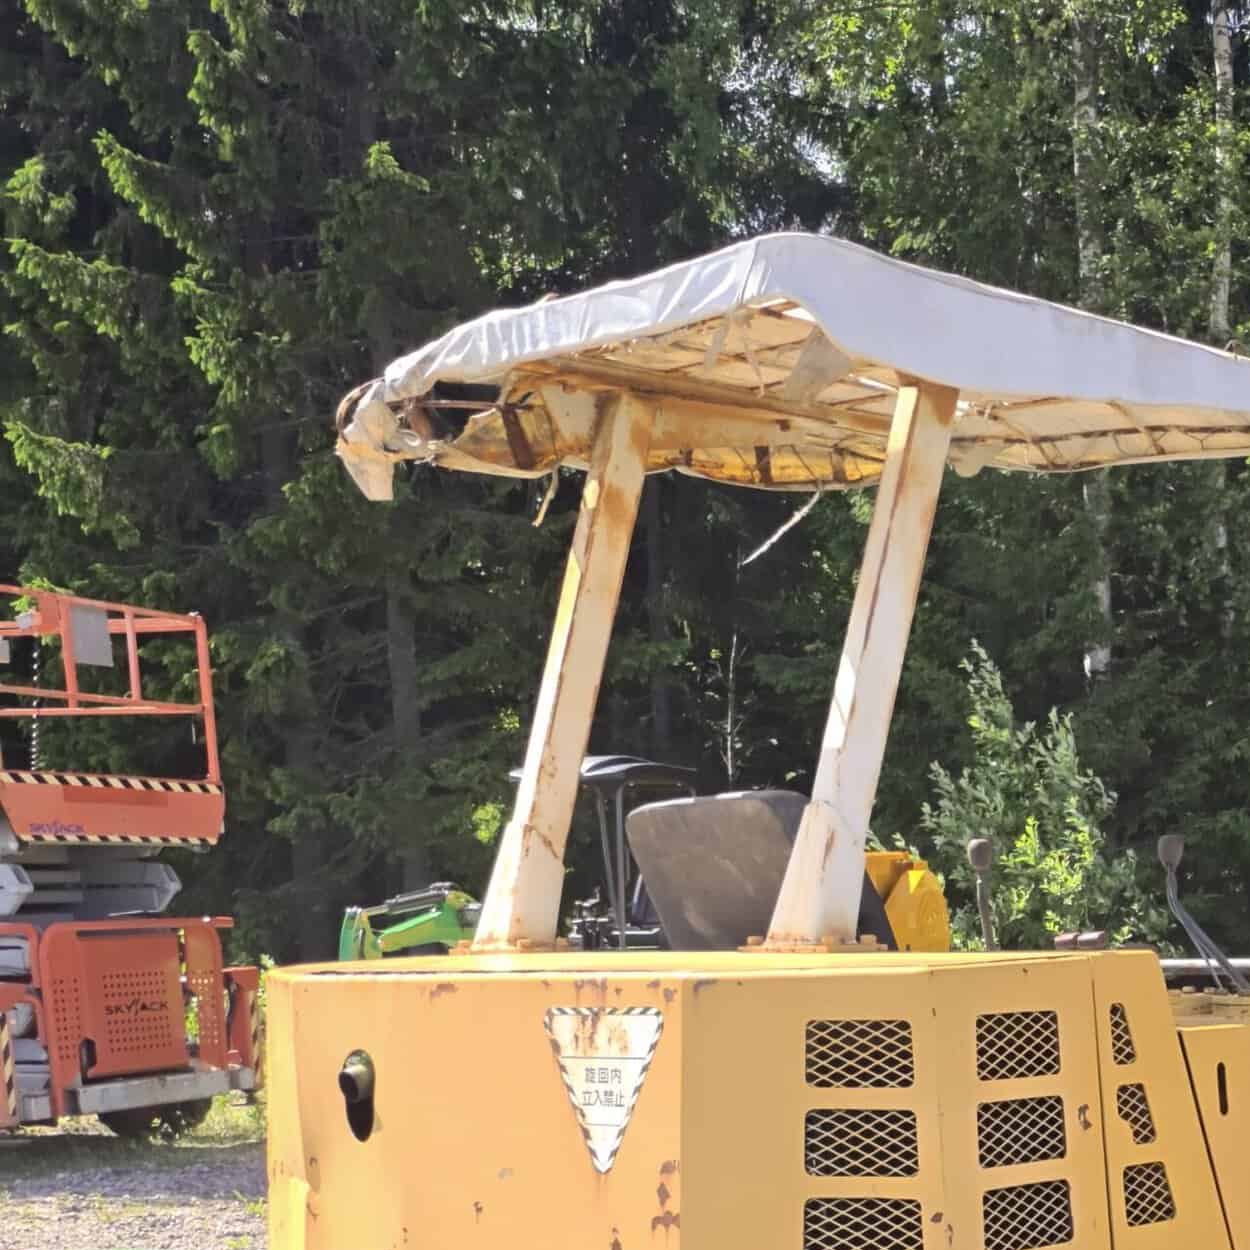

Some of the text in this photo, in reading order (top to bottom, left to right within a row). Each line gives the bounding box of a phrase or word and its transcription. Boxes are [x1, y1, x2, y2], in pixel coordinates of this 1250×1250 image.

[103, 1000, 168, 1015] SKYJACK
[582, 1089, 625, 1107] 立入禁止
